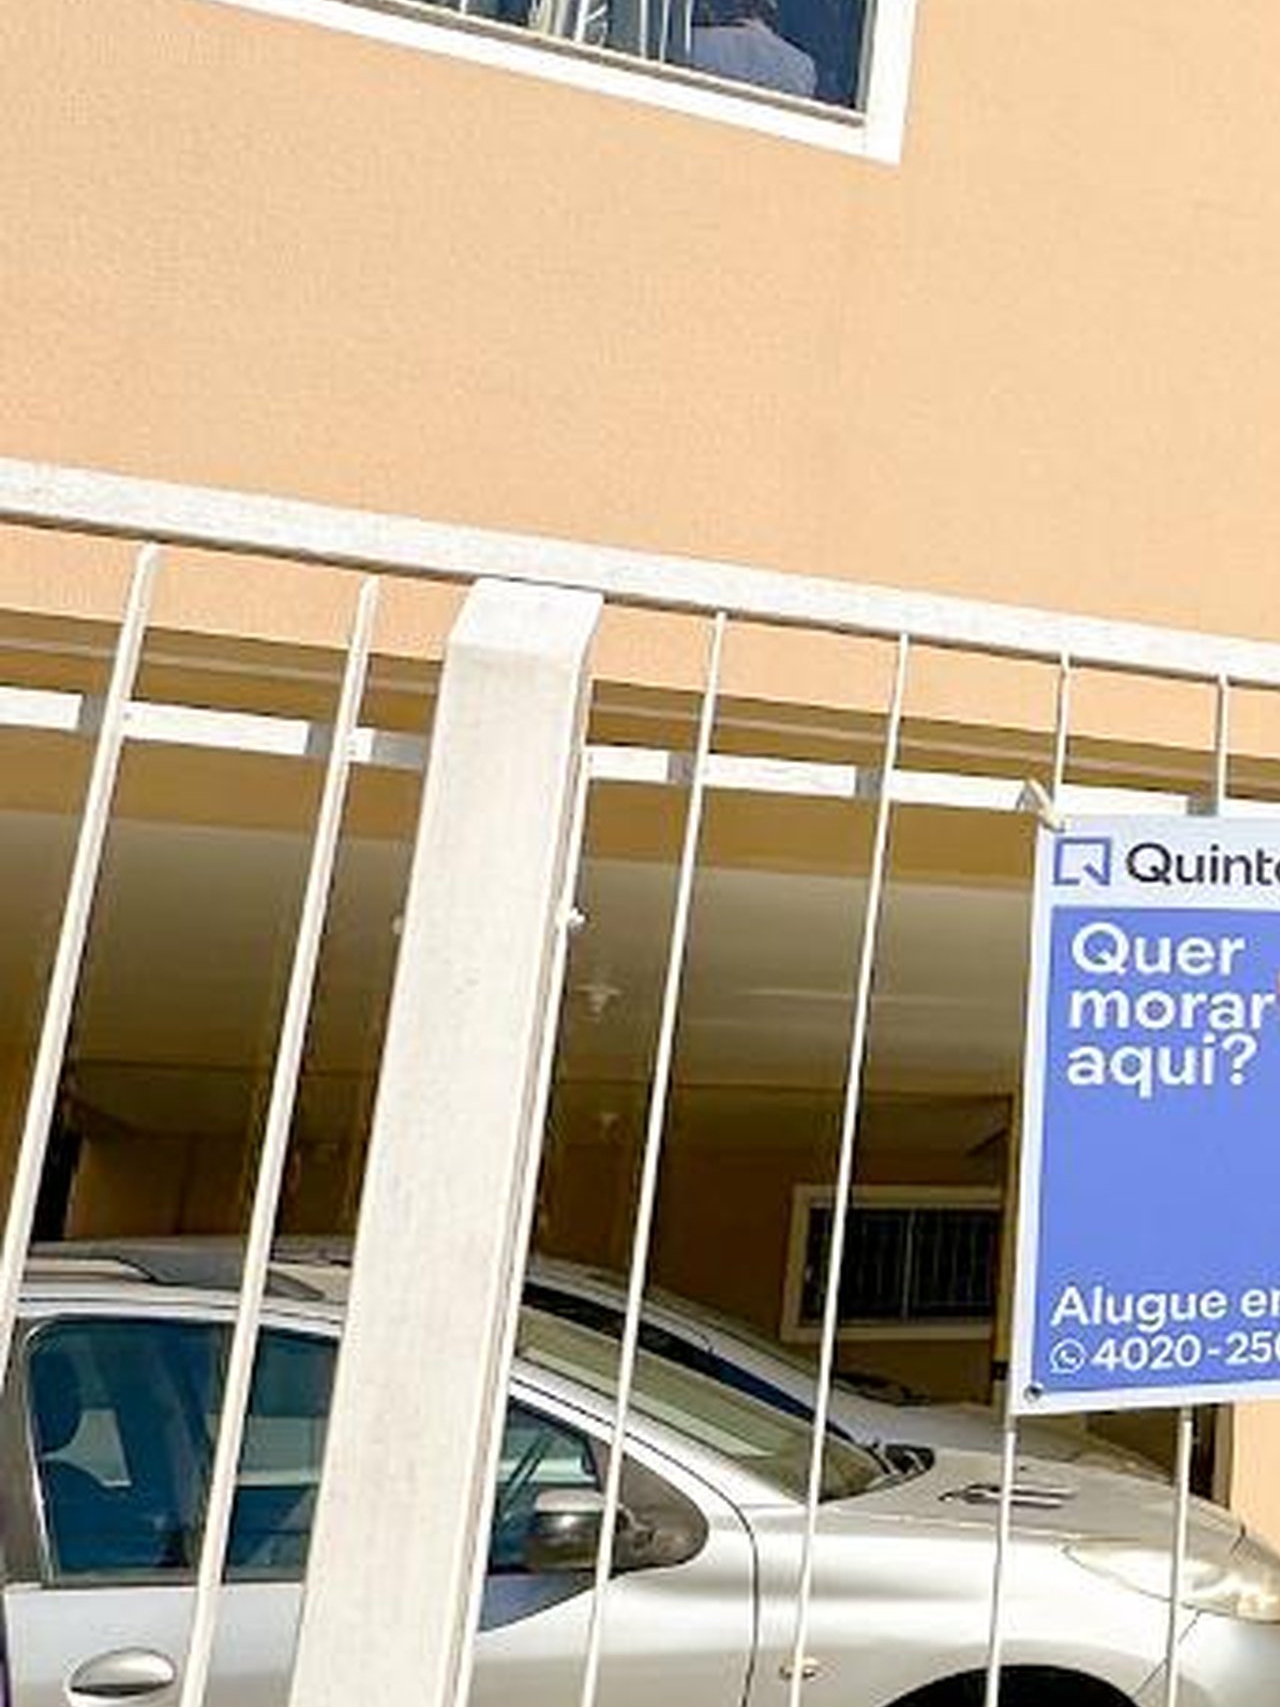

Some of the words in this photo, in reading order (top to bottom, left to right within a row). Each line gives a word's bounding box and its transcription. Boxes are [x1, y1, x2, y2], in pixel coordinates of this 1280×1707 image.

[1071, 922, 1246, 976] Quer
[1069, 990, 1275, 1031] morar
[1067, 1032, 1258, 1099] aqui?
[1050, 1286, 1228, 1332] Alugue
